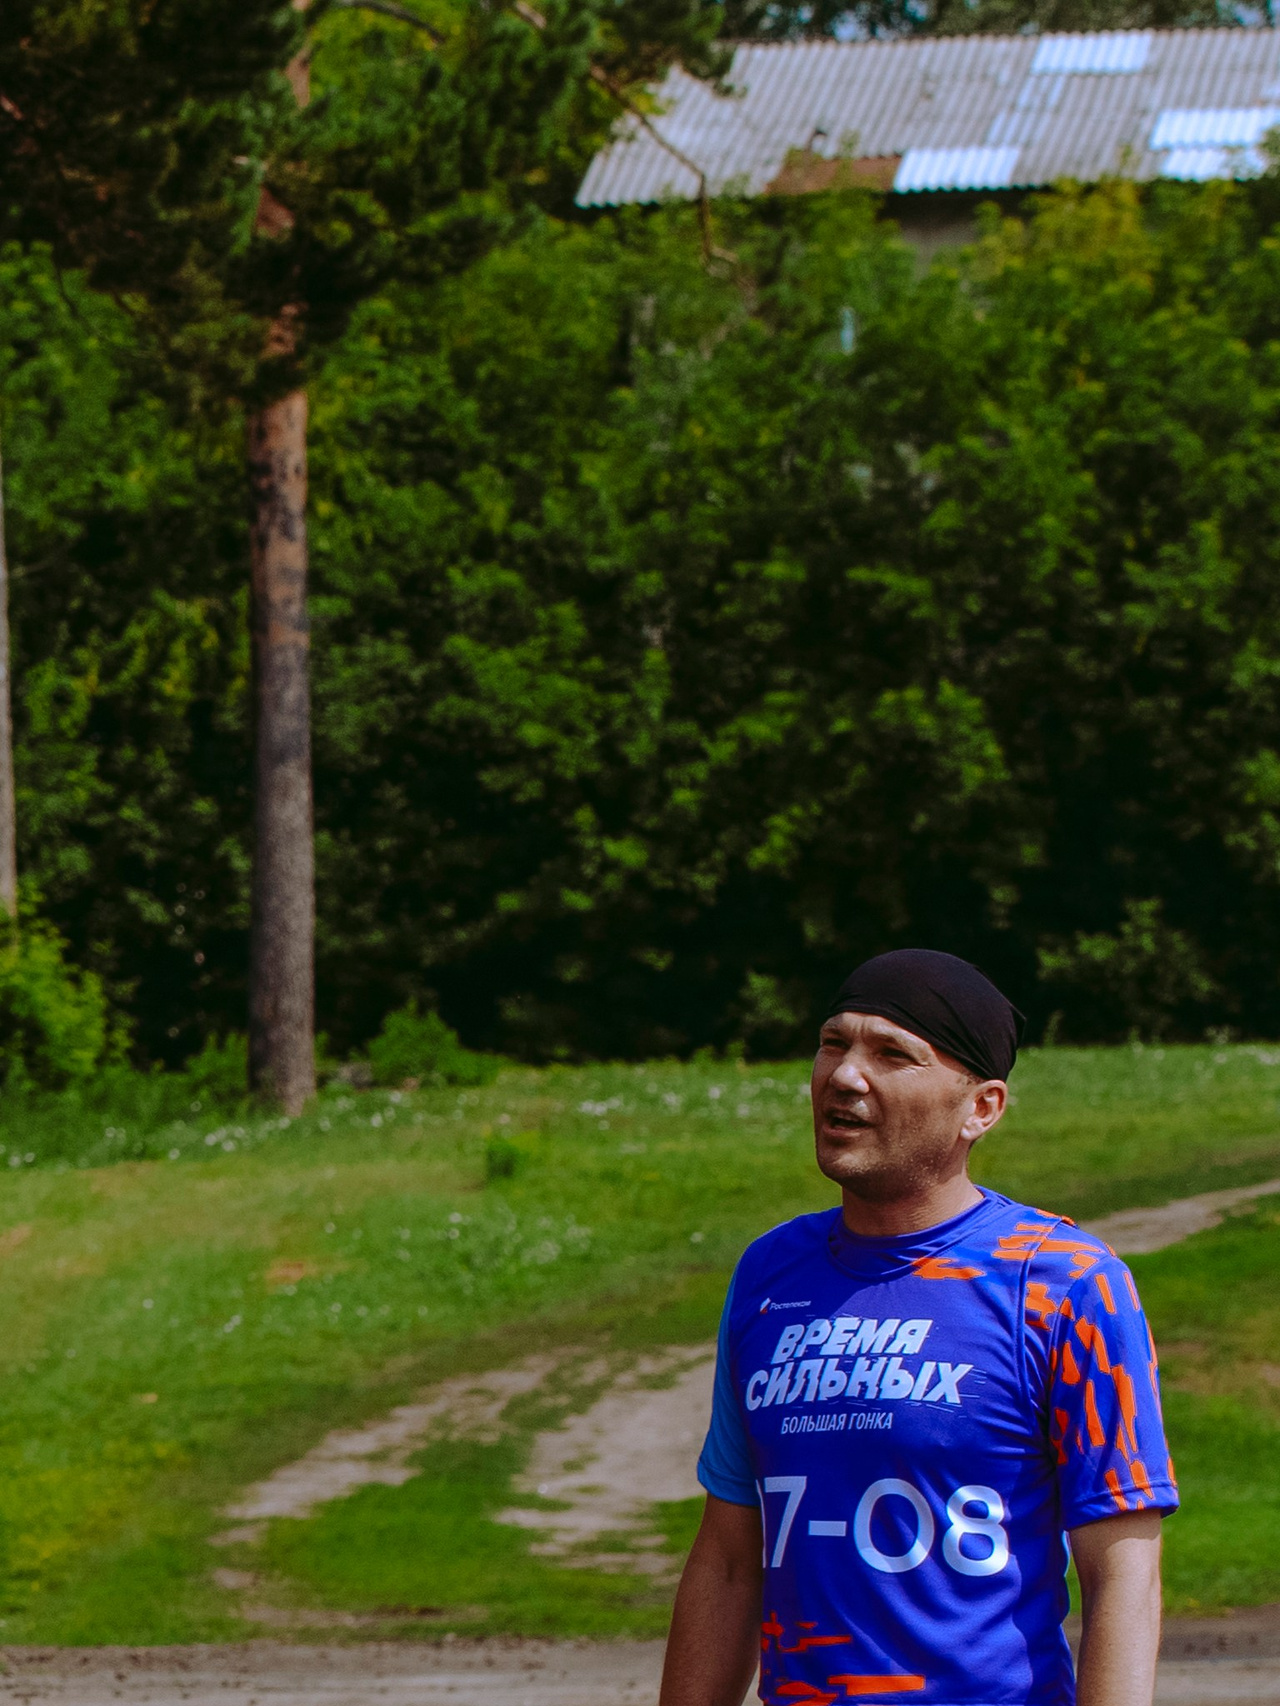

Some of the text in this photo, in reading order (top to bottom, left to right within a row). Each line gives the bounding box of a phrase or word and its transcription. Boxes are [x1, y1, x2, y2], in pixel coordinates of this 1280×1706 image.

[771, 1314, 933, 1364] ВРЕМЯ
[746, 1355, 974, 1411] СИЛЬНЫХ
[781, 1412, 894, 1436] БОЛЬШАЯ ГОНКА
[755, 1475, 1010, 1578] 7-08
